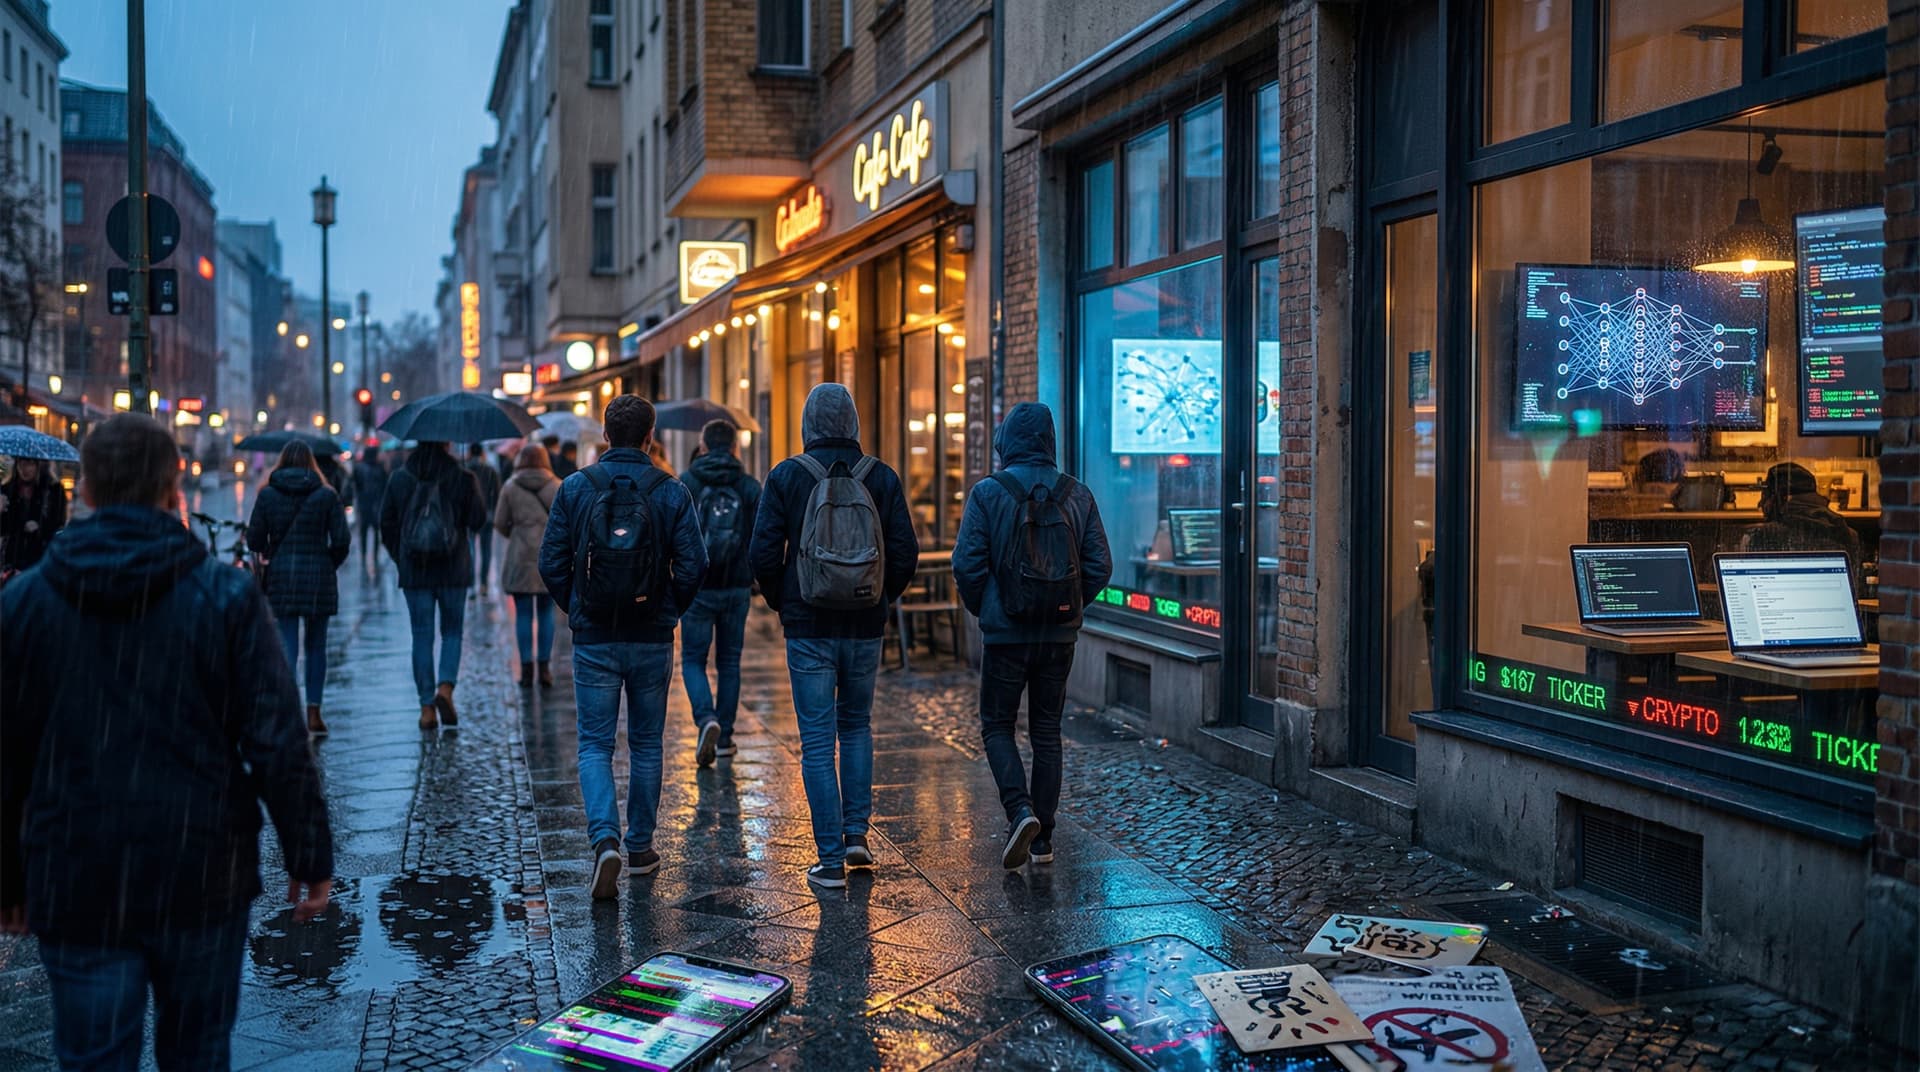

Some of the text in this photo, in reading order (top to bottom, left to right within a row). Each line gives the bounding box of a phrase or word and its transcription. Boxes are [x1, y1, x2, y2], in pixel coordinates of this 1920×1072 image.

[853, 99, 931, 211] Cafe Cafe
[1500, 665, 1536, 694] $167
[1547, 676, 1607, 711] TICKER
[1642, 696, 1720, 736] CRYPTO
